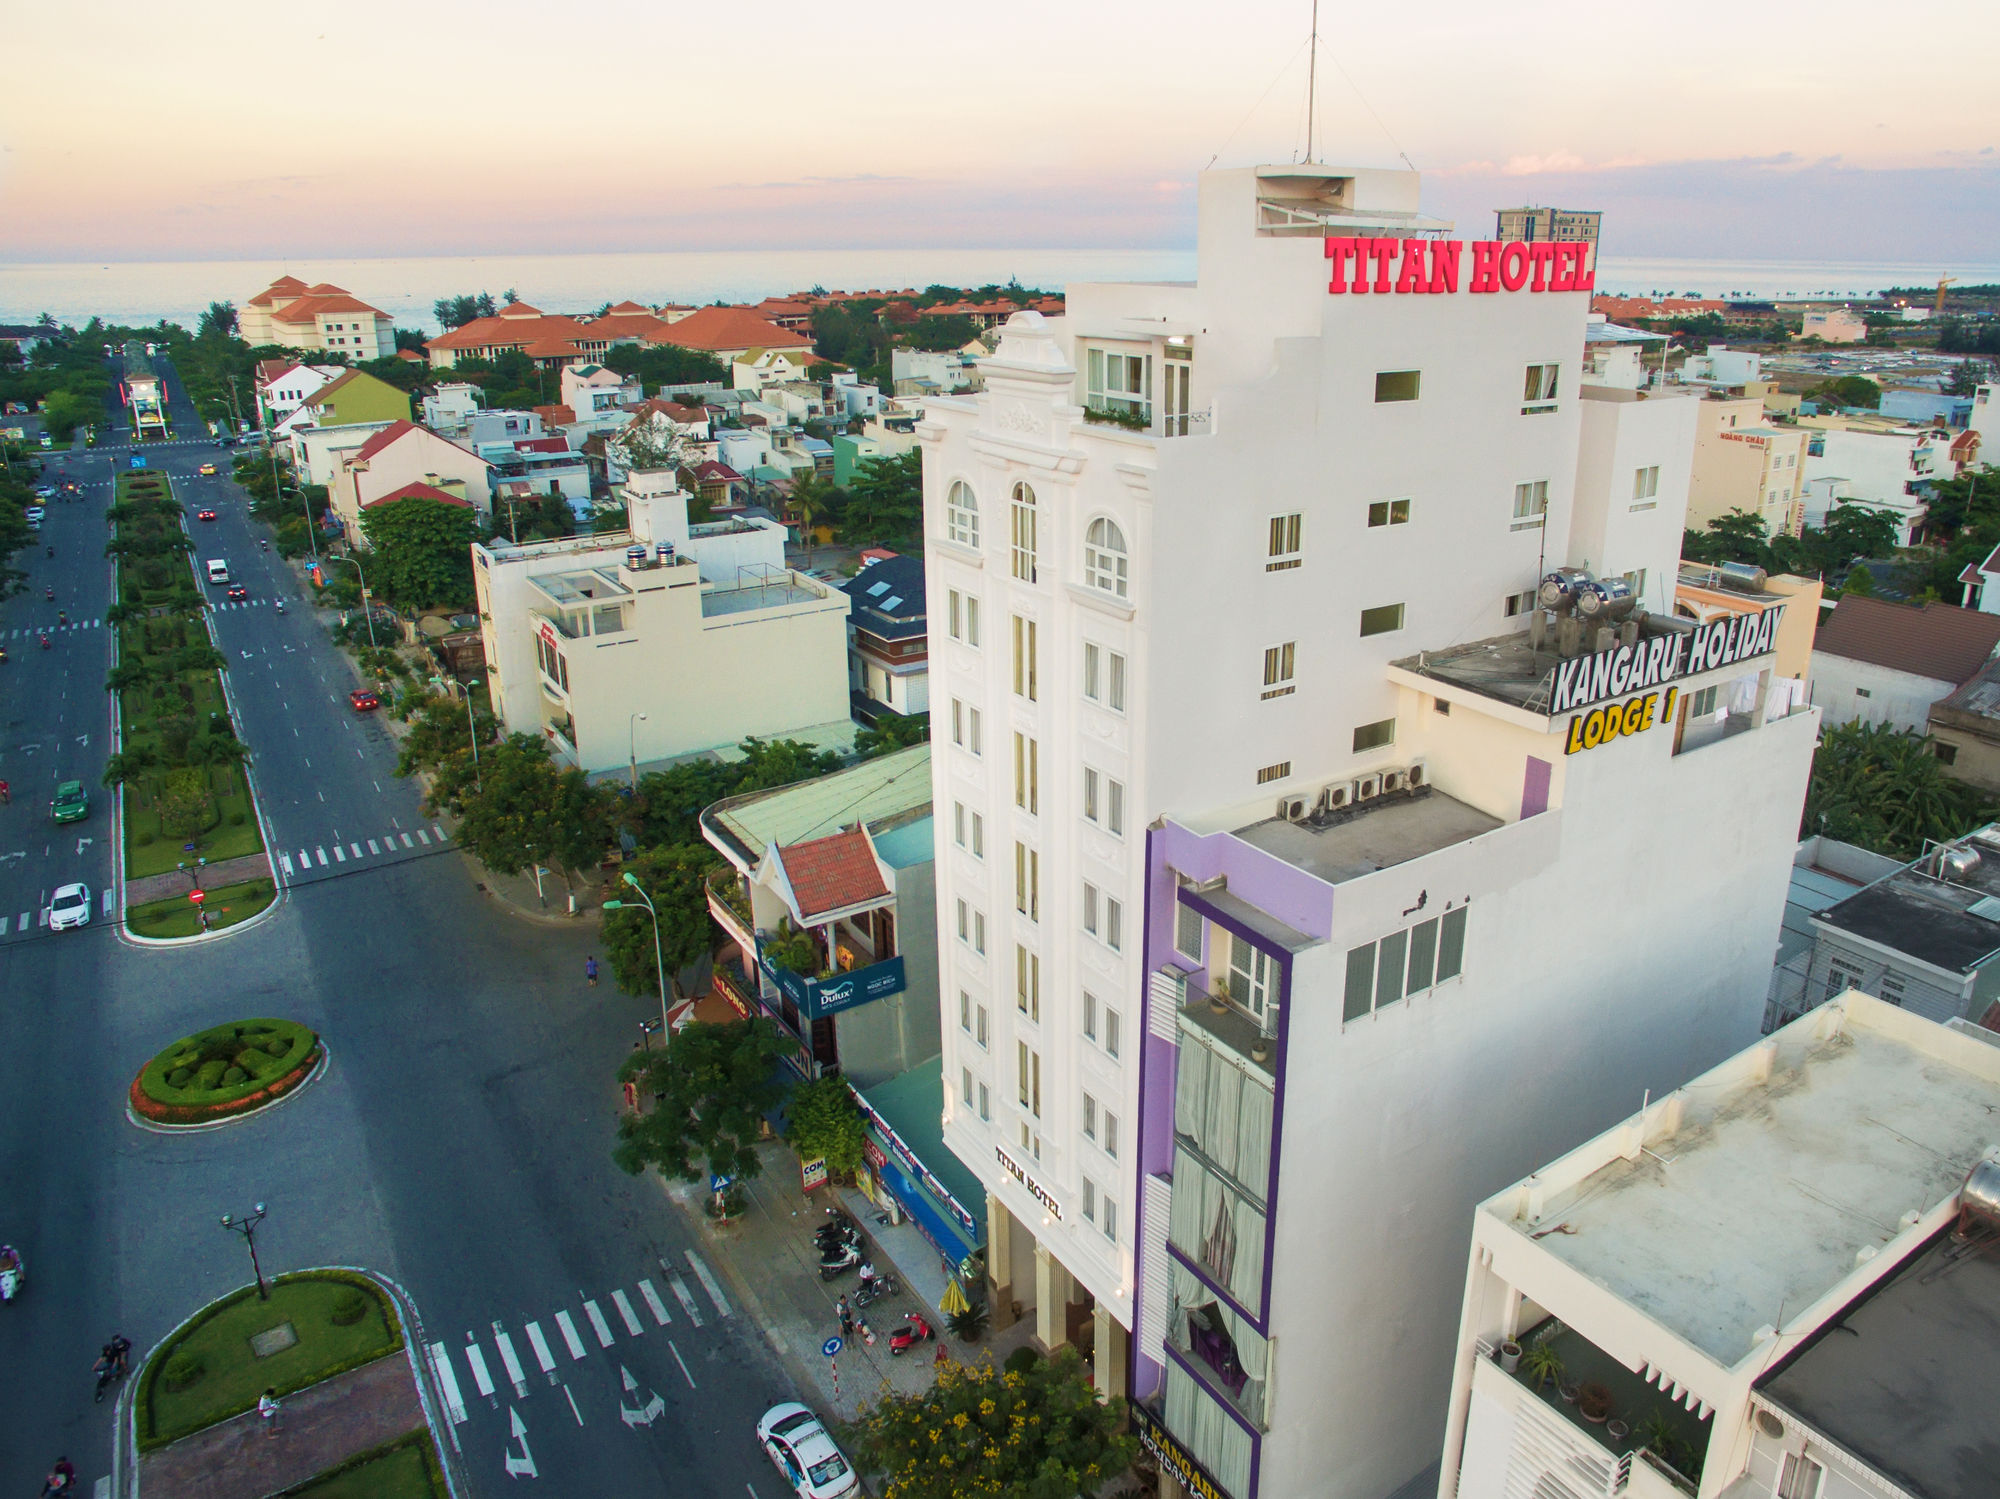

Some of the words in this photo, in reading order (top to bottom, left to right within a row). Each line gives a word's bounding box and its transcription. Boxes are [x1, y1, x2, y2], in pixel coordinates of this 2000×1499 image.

[1324, 236, 1463, 294] TITAN
[1469, 241, 1595, 293] HOTEL
[1551, 631, 1682, 713] KANGARU
[1686, 605, 1786, 675] HOLIDAY
[1564, 692, 1659, 755] LODGE
[1661, 686, 1678, 723] 1
[820, 990, 850, 1005] Dulux
[995, 1145, 1024, 1185] TITAN
[1027, 1176, 1063, 1222] HOTEL
